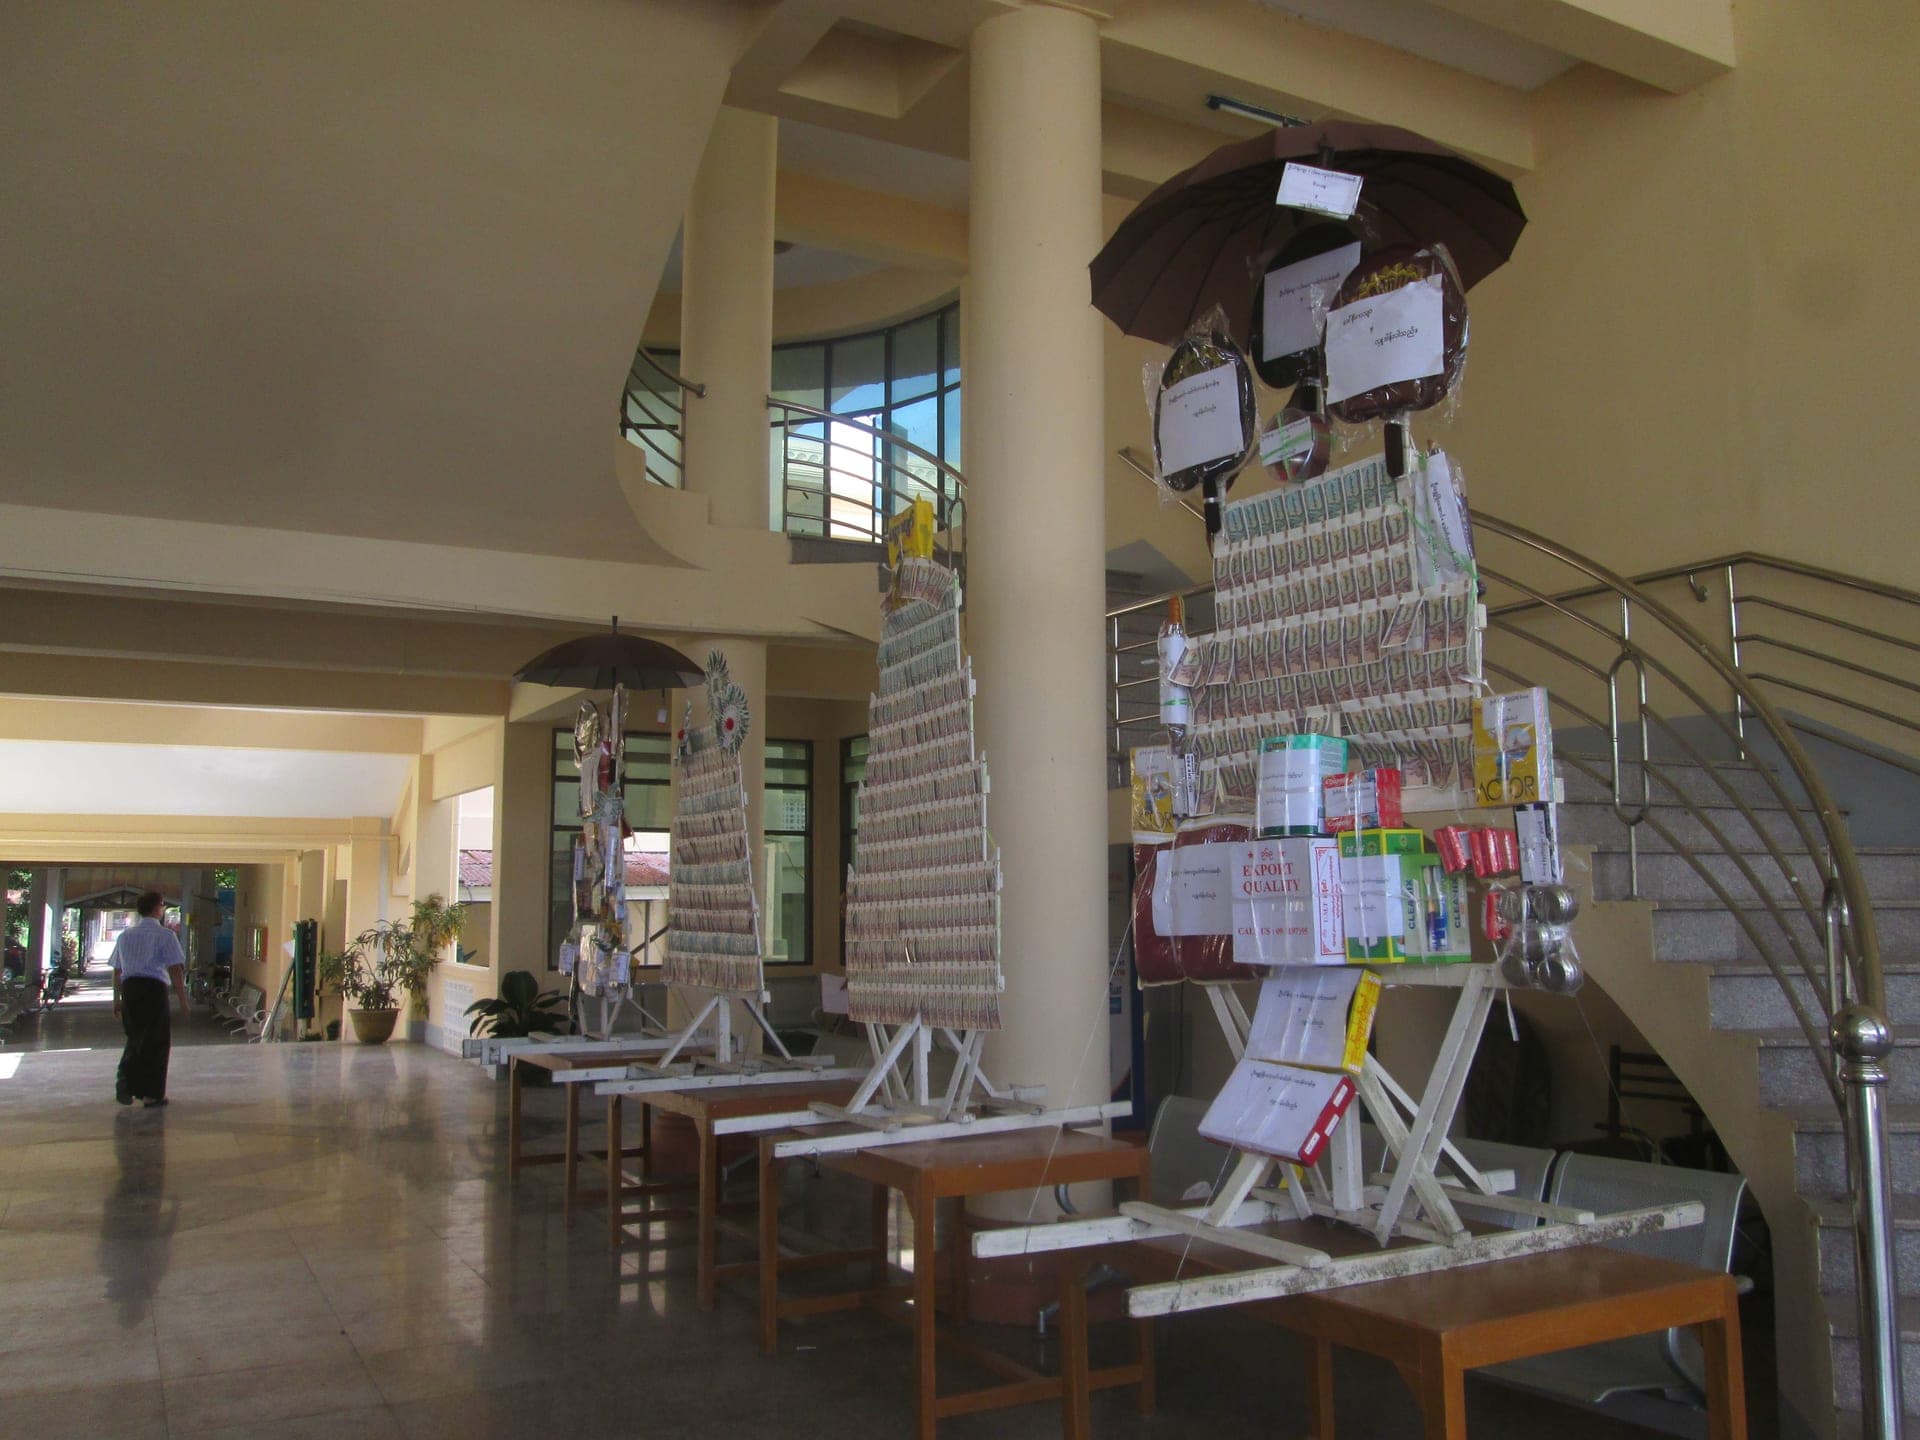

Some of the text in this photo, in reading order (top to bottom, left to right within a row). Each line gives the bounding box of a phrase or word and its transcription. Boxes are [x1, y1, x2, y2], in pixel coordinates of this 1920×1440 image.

[1477, 776, 1535, 802] ACOR
[1243, 863, 1293, 877] EXPORT
[1243, 879, 1299, 895] QUALITY
[1238, 927, 1258, 936] CAL
